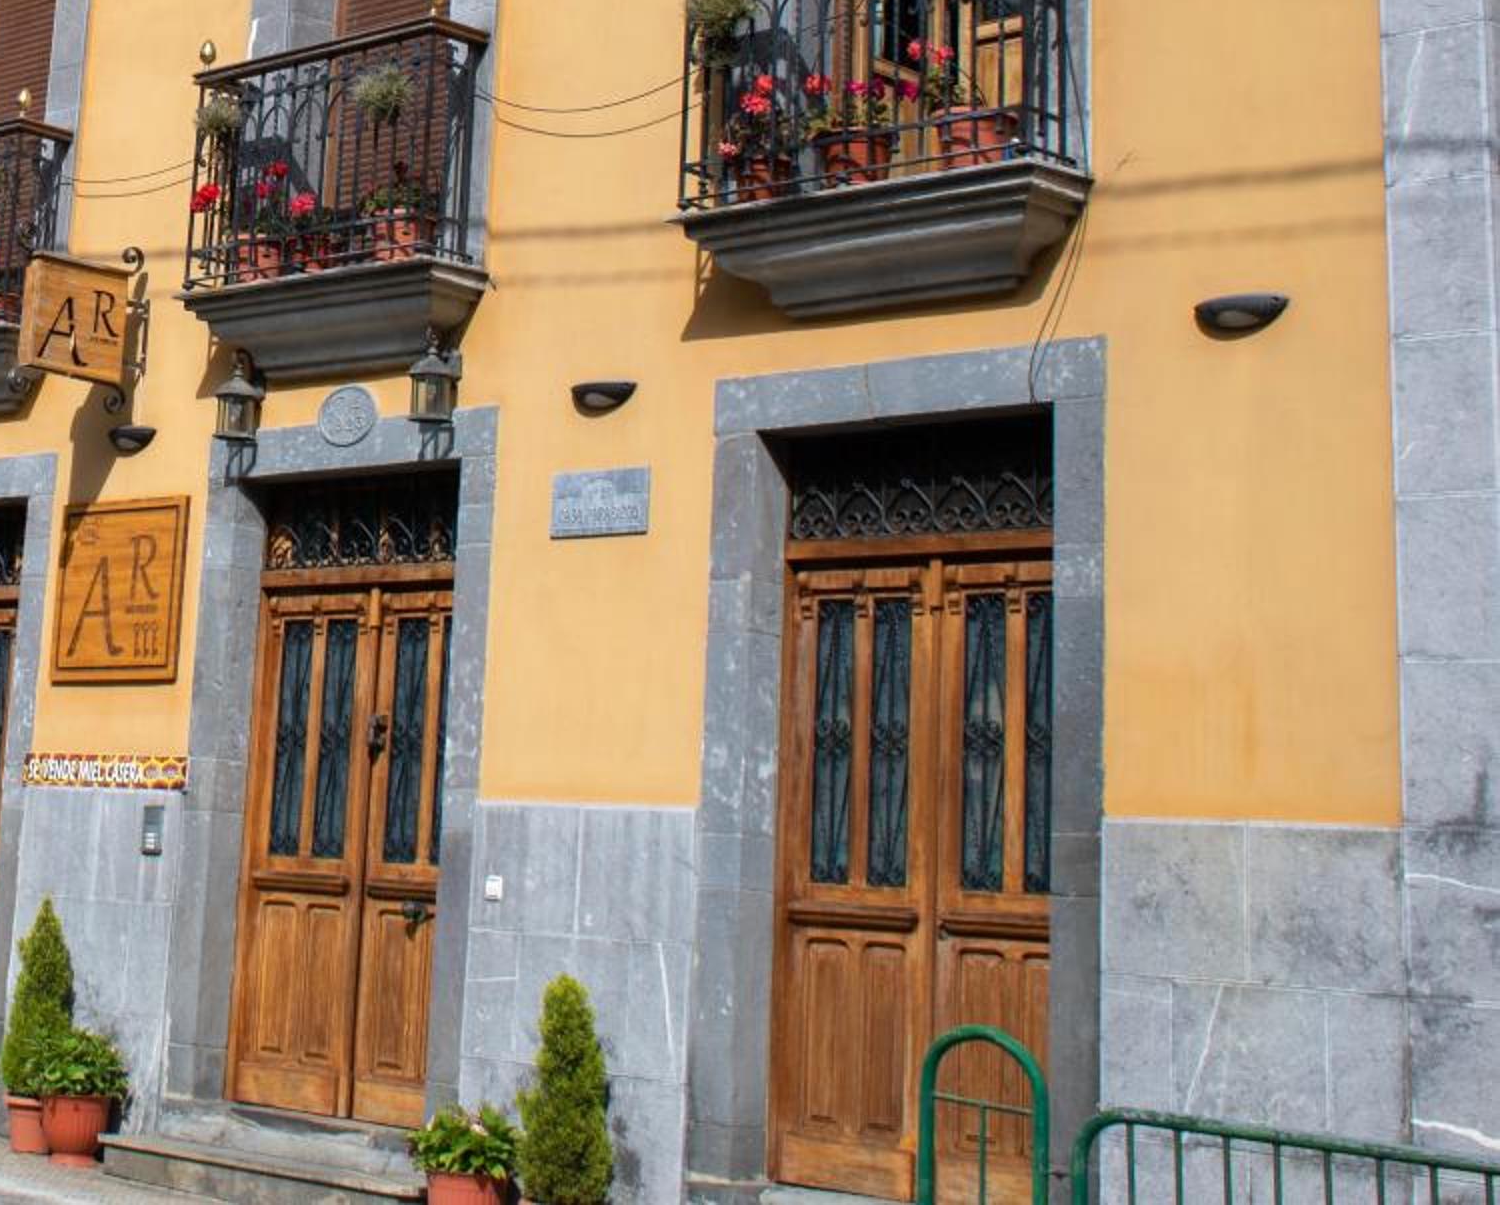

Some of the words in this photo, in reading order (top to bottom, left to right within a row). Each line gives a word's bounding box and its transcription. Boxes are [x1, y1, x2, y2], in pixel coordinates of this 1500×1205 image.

[28, 759, 39, 779] SE
[40, 760, 76, 780] VENDE
[77, 761, 103, 782] MIEL
[105, 762, 145, 783] CASERA
